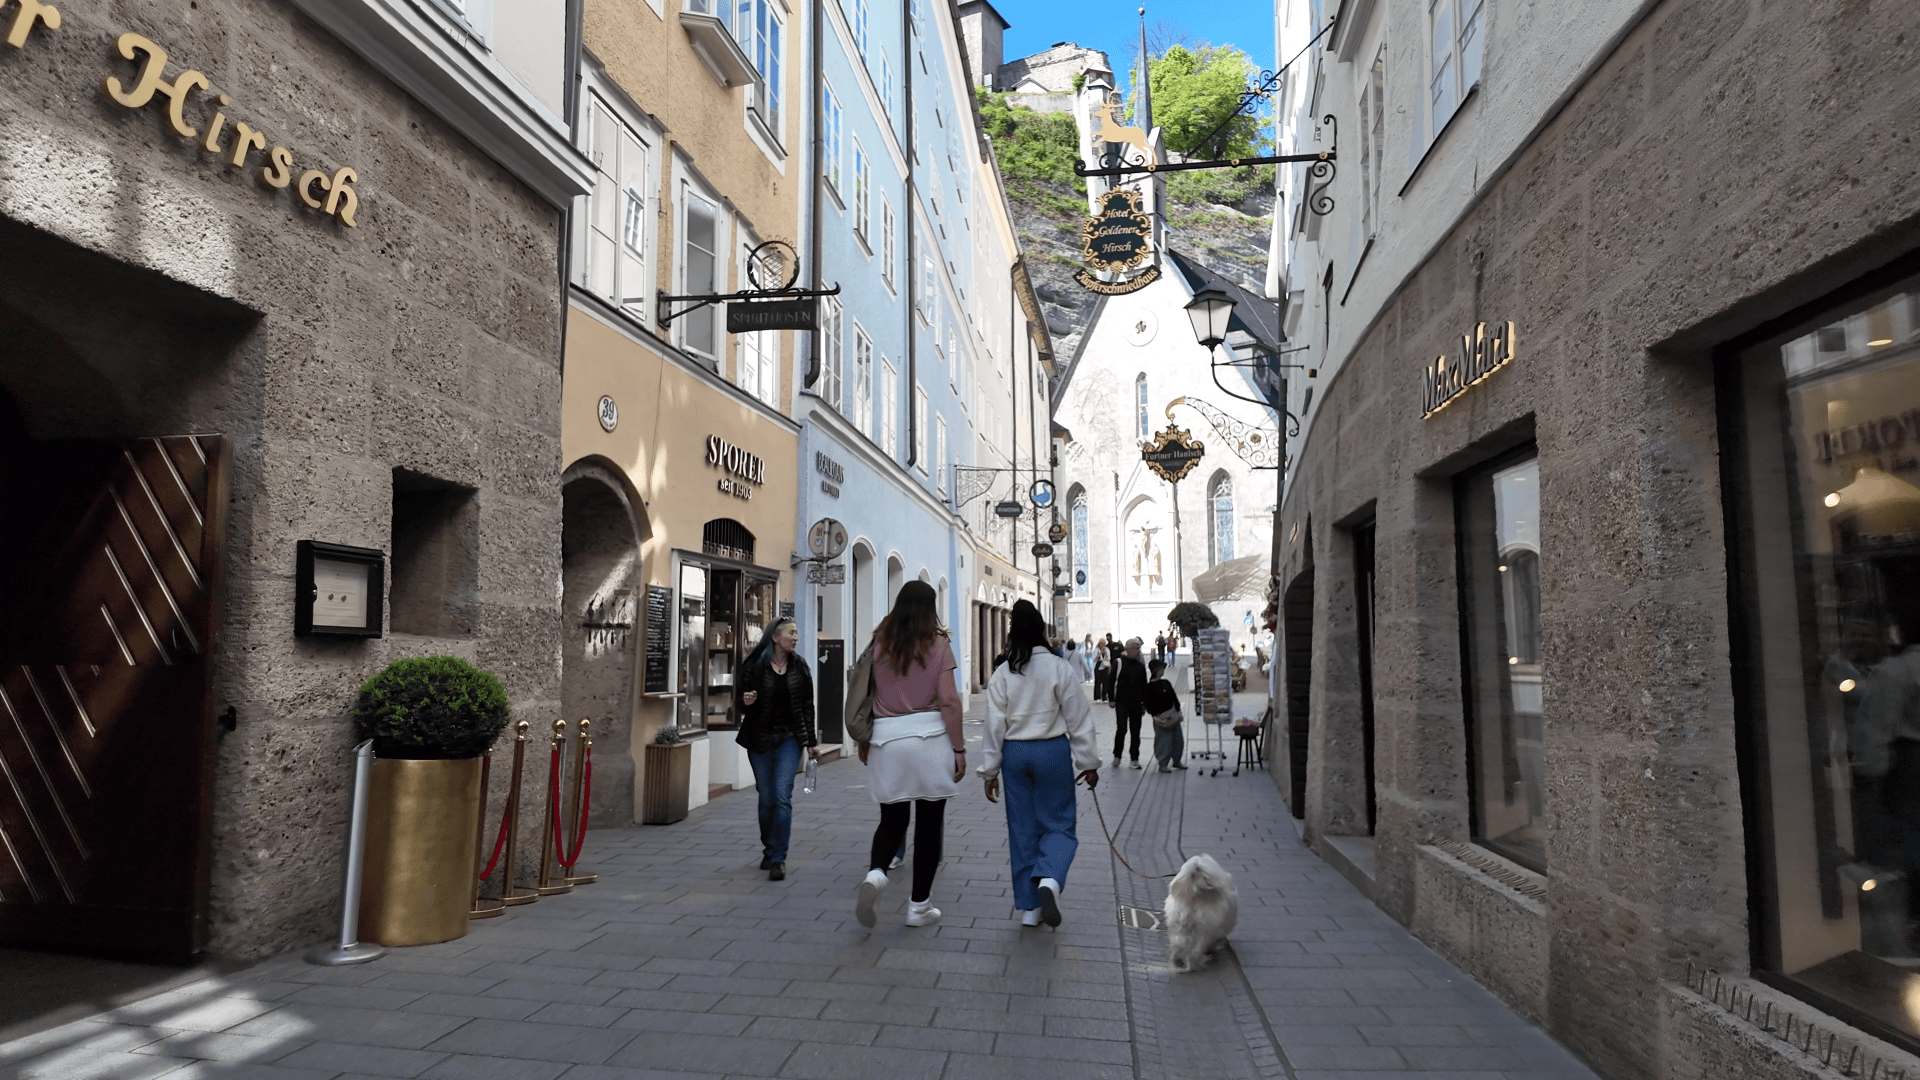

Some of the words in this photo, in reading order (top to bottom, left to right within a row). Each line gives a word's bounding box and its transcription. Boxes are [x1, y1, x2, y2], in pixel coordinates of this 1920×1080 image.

[0, 0, 61, 48] r
[106, 32, 358, 227] Hirsch
[1105, 209, 1130, 218] Hotel
[1100, 225, 1137, 237] Goldener
[1102, 242, 1131, 253] Hirsch
[1076, 269, 1158, 294] Kupferschmiedhaus
[733, 311, 811, 324] SPIRITUOSEN
[602, 398, 615, 420] 39
[706, 434, 766, 485] SPORER
[1145, 452, 1172, 461] Furtner
[1173, 449, 1202, 459] Hanisch
[718, 478, 733, 494] seit
[735, 482, 752, 500] 1903
